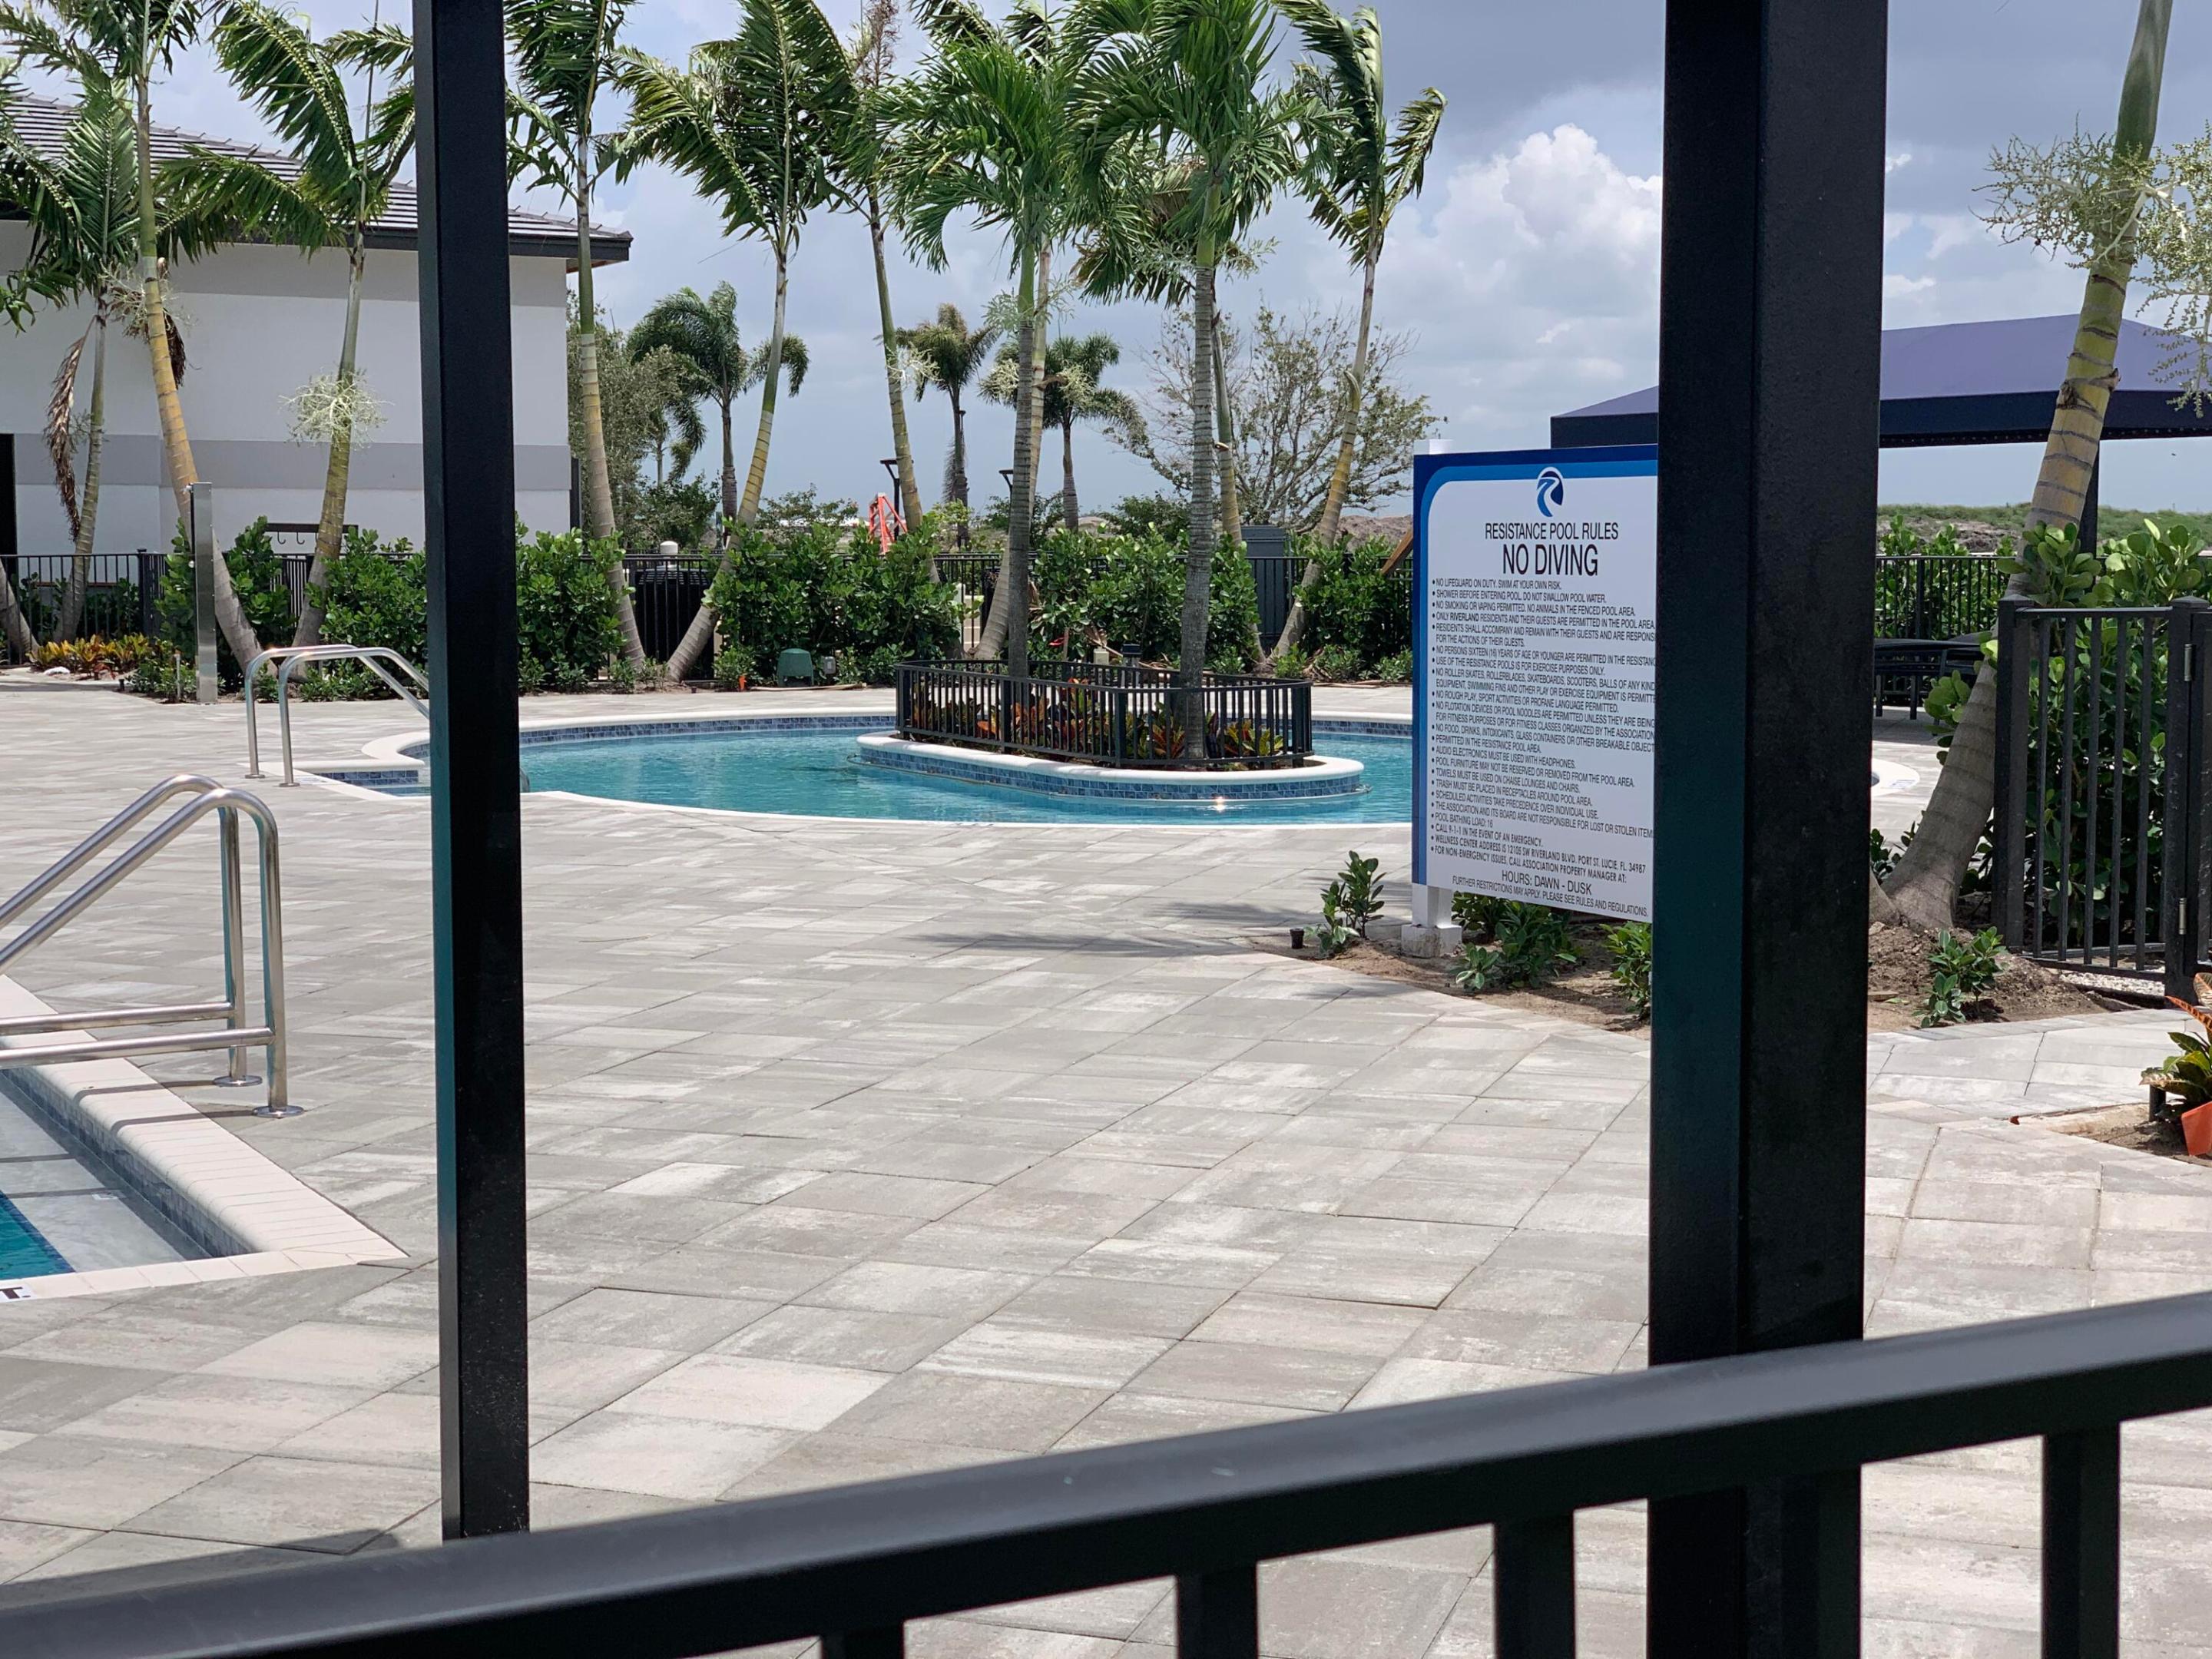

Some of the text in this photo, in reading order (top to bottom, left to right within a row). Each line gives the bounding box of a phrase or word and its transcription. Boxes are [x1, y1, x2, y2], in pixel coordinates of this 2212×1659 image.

[1485, 522, 1619, 540] RESISTANCE POOL RULES
[1503, 544, 1598, 576] NO DIVING
[1436, 578, 1443, 587] NO
[1445, 578, 1472, 588] LIFEGUARD
[1474, 579, 1482, 588] ON
[1498, 580, 1512, 588] SWIM
[1513, 580, 1519, 589] AT
[1519, 580, 1533, 589] YOUR
[1535, 581, 1547, 589] OWN
[1436, 590, 1459, 598] SHOWER
[1459, 590, 1479, 599] BEFORE
[1481, 591, 1505, 600] ENTERING
[1523, 592, 1531, 601] DO
[1532, 592, 1542, 601] NOT
[1544, 592, 1569, 602] SWALLOW
[1571, 593, 1585, 602] POOL
[1436, 601, 1444, 609] NO
[1445, 601, 1468, 610] SMOKING
[1469, 602, 1477, 611] OR
[1478, 602, 1495, 611] VAPING
[1528, 604, 1535, 613] NO
[1536, 604, 1558, 614] ANIMALS
[1560, 604, 1565, 614] IN
[1566, 605, 1577, 614] THE
[1578, 605, 1600, 615] FENCED
[1602, 606, 1617, 615] POOL
[1436, 612, 1449, 621] ONLY
[1450, 612, 1479, 622] RIVERLAND
[1481, 614, 1508, 623] RESIDENTS
[1509, 614, 1520, 624] AND
[1520, 615, 1535, 624] THEIR
[1536, 616, 1556, 625] GUESTS
[1558, 617, 1568, 625] ARE
[1569, 617, 1600, 627] PERMITTED
[1602, 618, 1608, 628] IN
[1608, 618, 1620, 628] THE
[1621, 619, 1637, 628] POOL
[1436, 634, 1446, 643] FOR
[1448, 634, 1458, 644] THE
[1458, 635, 1480, 644] ACTIONS
[1482, 636, 1488, 645] OF
[1488, 637, 1503, 646] THEIR
[1436, 657, 1446, 665] USE
[1448, 657, 1455, 666] OF
[1455, 657, 1465, 667] THE
[1466, 658, 1496, 668] RESISTANCE
[1498, 660, 1515, 670] POOLS
[1515, 661, 1521, 670] IS
[1522, 661, 1532, 671] FOR
[1533, 662, 1558, 672] EXERCISE
[1559, 664, 1588, 674] PURPOSES
[1436, 690, 1444, 699] NO
[1445, 690, 1463, 700] ROUGH
[1479, 693, 1495, 703] SPORT
[1496, 694, 1522, 705] ACTIVITIES
[1522, 697, 1530, 706] OR
[1531, 697, 1554, 707] PROFANE
[1555, 699, 1584, 710] LANGUAGE
[1436, 757, 1449, 767] POOL
[1451, 758, 1479, 770] FURNITURE
[1480, 761, 1490, 771] MAY
[1491, 763, 1501, 772] NOT
[1502, 763, 1508, 773] BE
[1509, 765, 1535, 776] RESERVED
[1536, 767, 1544, 777] OR
[1545, 769, 1571, 780] REMOVED
[1571, 772, 1588, 782] FROM
[1589, 773, 1600, 783] THE
[1601, 775, 1617, 785] POOL
[1436, 779, 1452, 789] TRASH
[1453, 781, 1468, 791] MUST
[1469, 783, 1475, 792] BE
[1476, 783, 1495, 794] PLACED
[1496, 786, 1502, 795] IN
[1502, 786, 1536, 800] RECEPTACLES
[1538, 791, 1559, 803] AROUND
[1561, 794, 1575, 804] POOL
[1435, 801, 1445, 810] THE
[1446, 803, 1479, 815] ASSOCIATION
[1479, 806, 1490, 816] AND
[1500, 810, 1516, 820] BOARD
[1517, 812, 1527, 822] ARE
[1528, 813, 1538, 823] NOT
[1539, 815, 1576, 829] RESPONSIBLE
[1578, 820, 1589, 830] FOR
[1590, 822, 1604, 832] LOST
[1605, 823, 1613, 833] OR
[1614, 825, 1637, 836] STOLEN
[1637, 828, 1654, 839] ITEM
[1435, 812, 1449, 822] POOL
[1450, 814, 1470, 825] BATHING
[1488, 819, 1493, 828] 16
[1435, 823, 1447, 833] CALL
[1449, 825, 1461, 835] 9-1-1
[1462, 827, 1468, 836] IN
[1469, 828, 1478, 837] THE
[1479, 830, 1494, 839] EVENT
[1495, 832, 1502, 841] OF
[1502, 833, 1510, 842] AN
[1435, 834, 1459, 846] WELLNESS
[1459, 838, 1477, 849] CENTER
[1479, 840, 1501, 853] ADDRESS
[1502, 844, 1506, 853] IS
[1522, 847, 1530, 856] SW
[1532, 849, 1561, 861] RIVERLAND
[1578, 856, 1592, 866] PORT
[1629, 863, 1646, 874] 34987
[1435, 846, 1444, 855] FOR
[1445, 847, 1490, 863] NON-EMERGENCY
[1509, 856, 1521, 867] CALL
[1522, 859, 1558, 873] ASSOCIATION
[1560, 865, 1586, 877] PROPERTY
[1588, 869, 1617, 882] MANAGER
[1502, 869, 1532, 886] HOURS:
[1535, 876, 1560, 889] DAWN
[1568, 880, 1591, 895] DUSK
[1452, 876, 1475, 887] FURTHER
[1476, 879, 1512, 894] RESTRICTIONS
[1513, 886, 1523, 896] MAY
[1542, 891, 1563, 902] PLEASE
[1565, 894, 1575, 904] SEE
[1576, 896, 1594, 907] RULES
[1594, 899, 1606, 909] AND
[1608, 902, 1648, 916] REGULATIONS.
